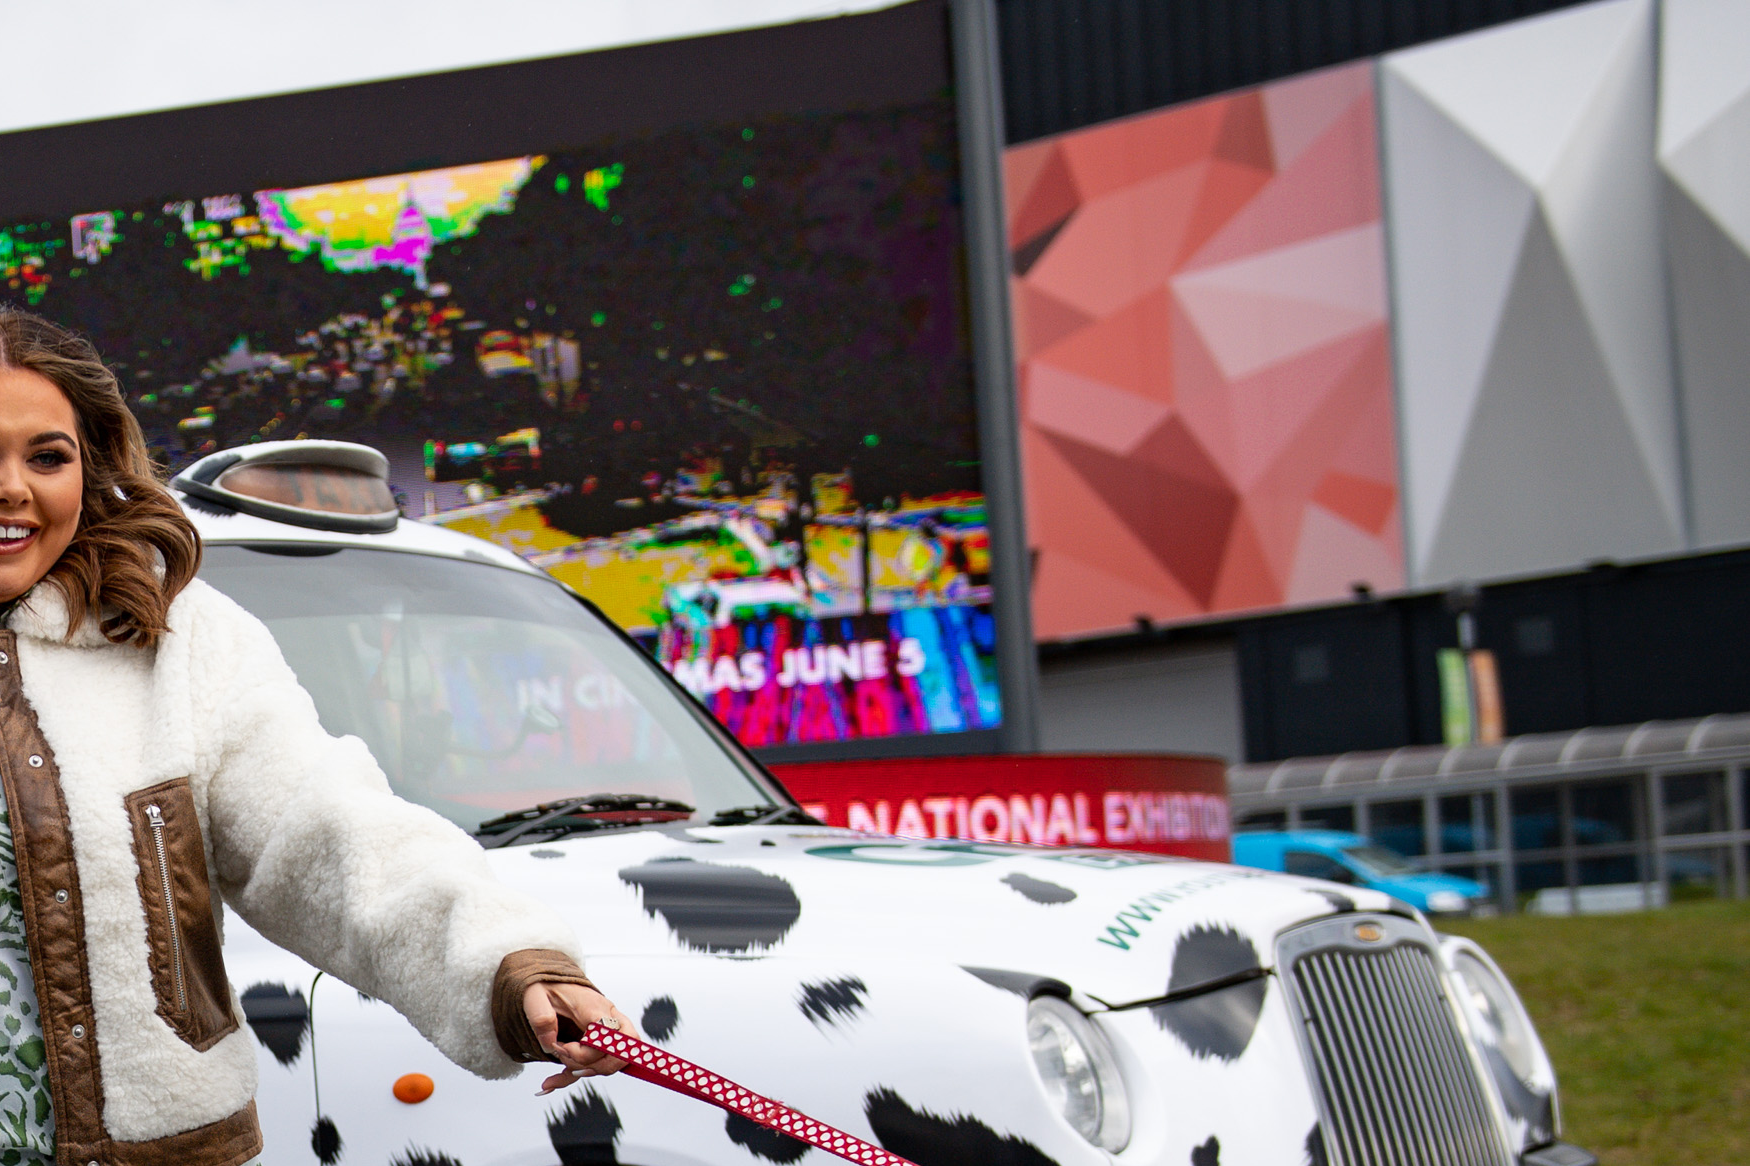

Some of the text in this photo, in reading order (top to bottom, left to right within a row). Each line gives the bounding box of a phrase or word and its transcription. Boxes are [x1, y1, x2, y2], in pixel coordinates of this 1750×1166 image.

[517, 676, 562, 711] IN
[777, 641, 888, 688] JUNE
[896, 637, 926, 676] 5
[848, 793, 1099, 846] NATIONAL
